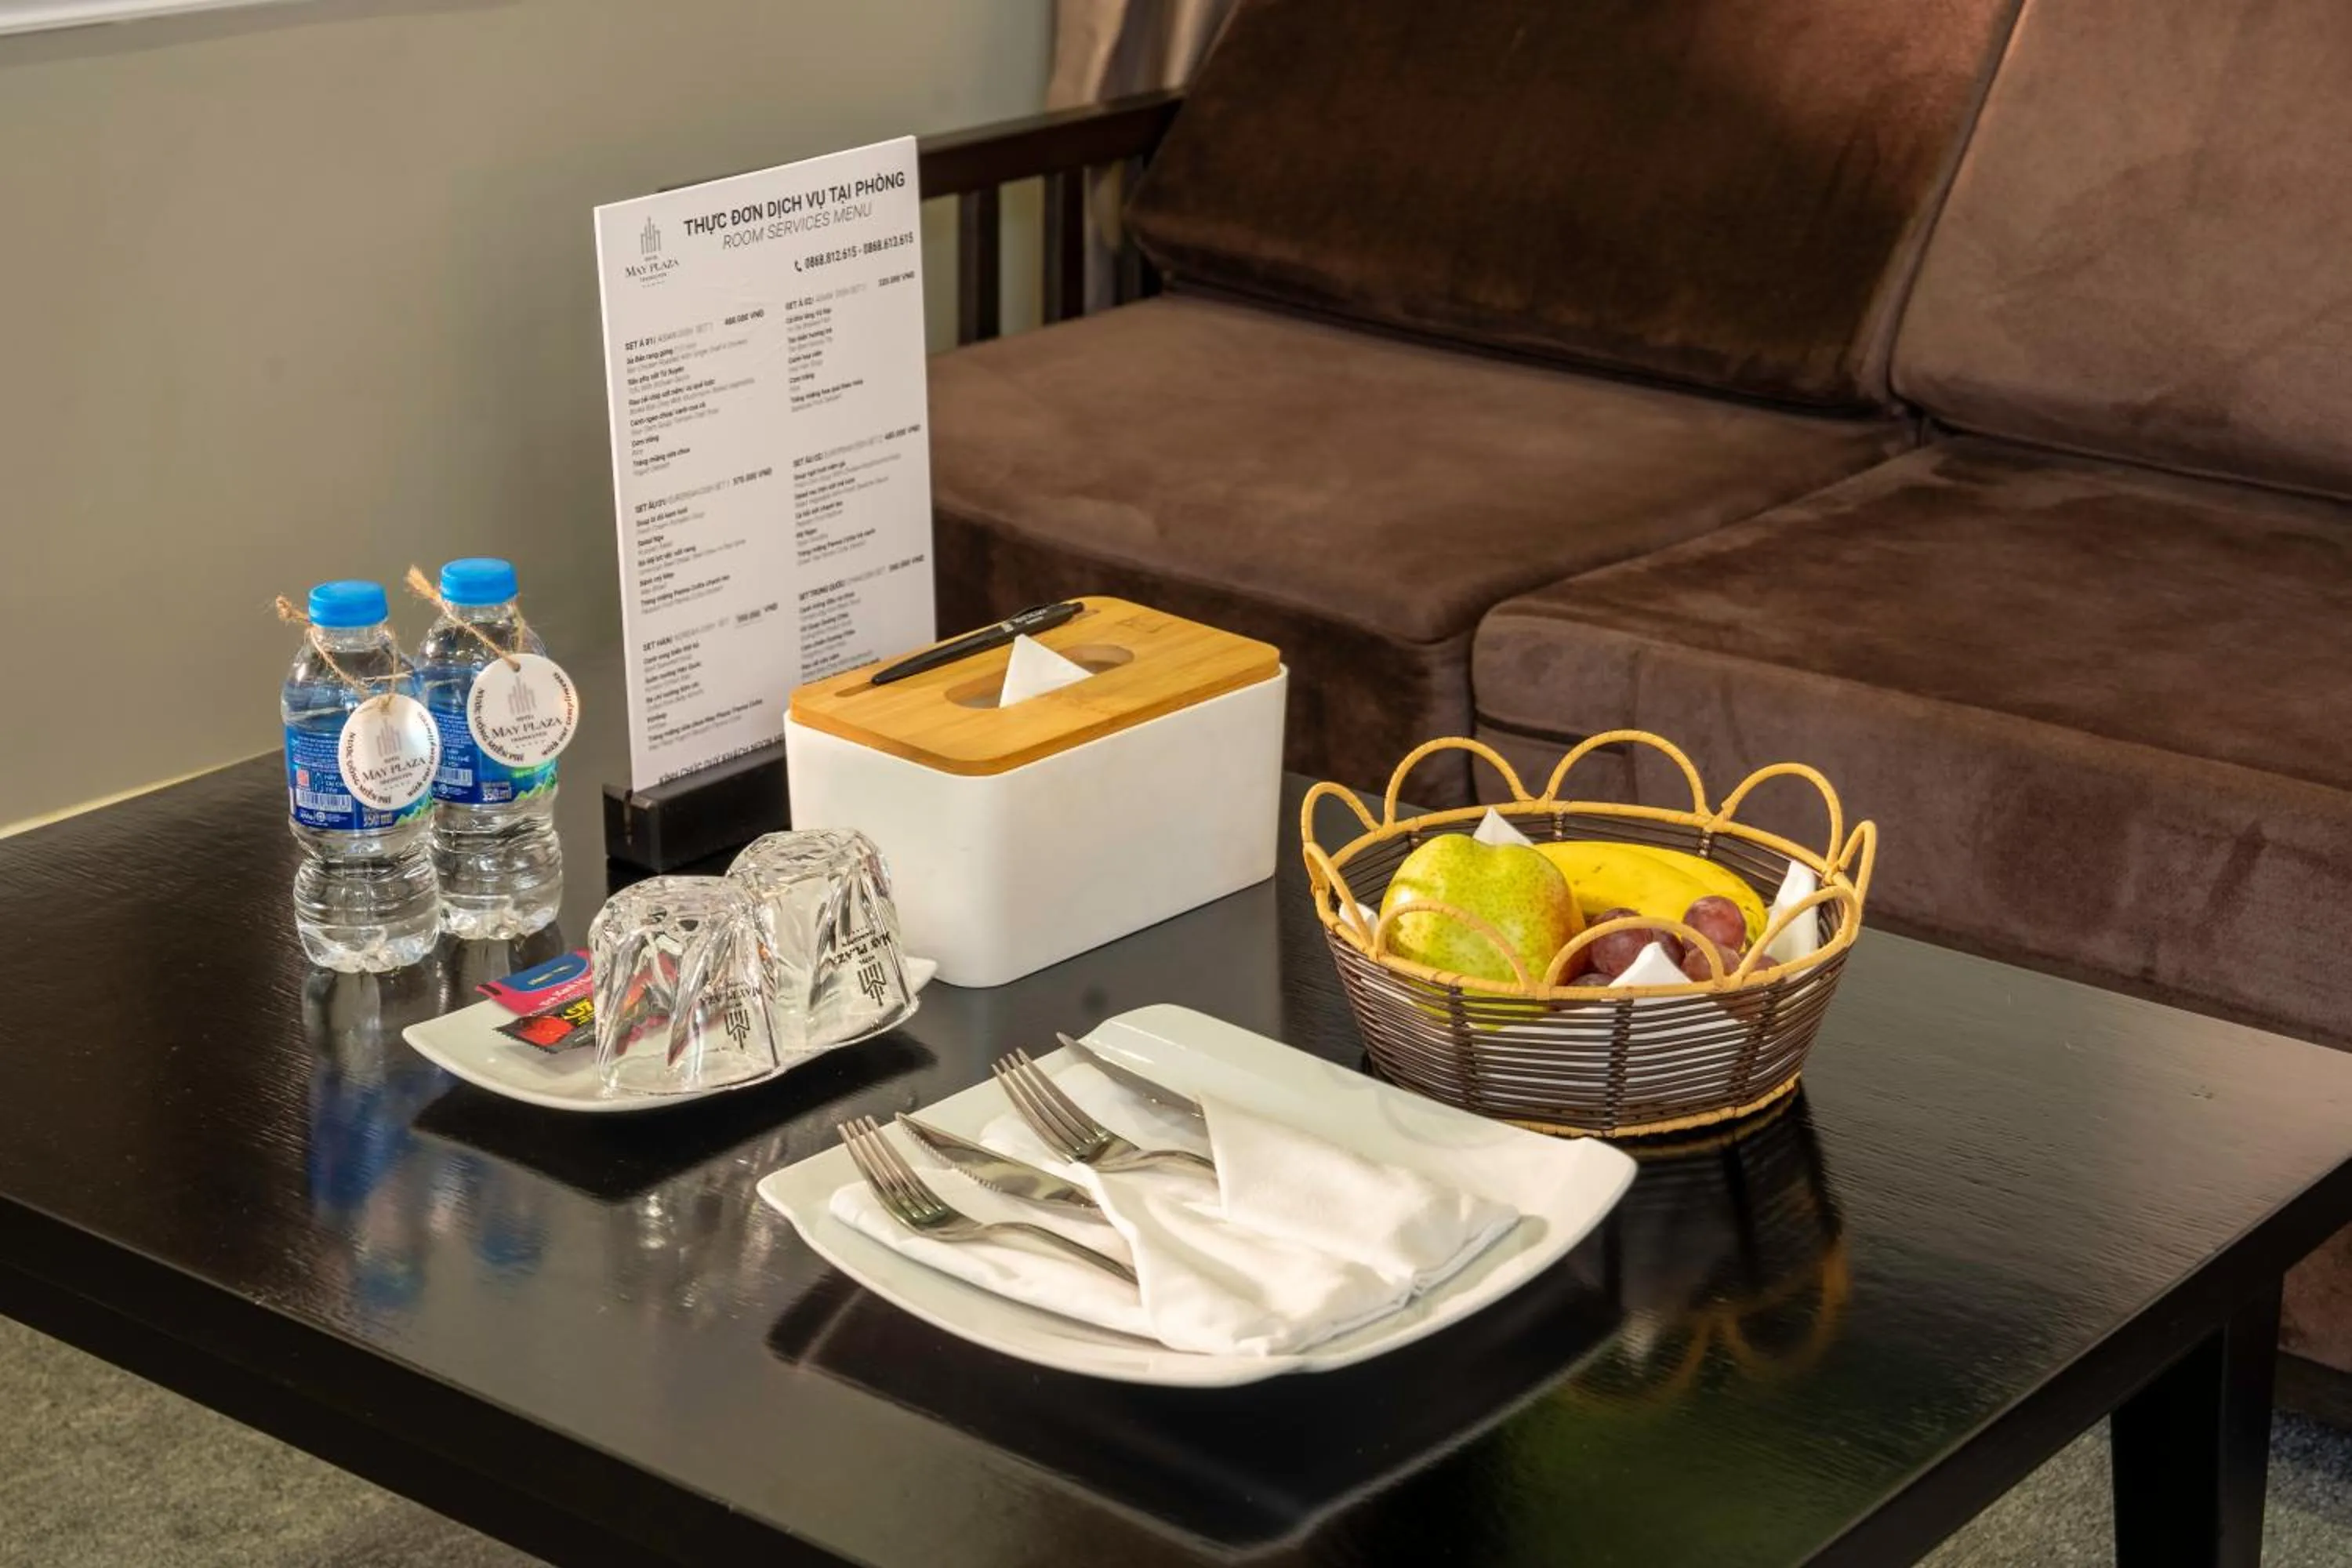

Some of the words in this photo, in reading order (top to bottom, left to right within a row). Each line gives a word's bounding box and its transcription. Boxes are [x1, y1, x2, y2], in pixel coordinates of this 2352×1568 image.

[684, 212, 728, 236] THỰC
[731, 204, 764, 226] ĐƠN
[768, 195, 802, 219] DỊCH
[805, 189, 826, 209] VỤ
[829, 183, 851, 202] TẠI
[855, 172, 906, 198] PHÒNG
[723, 229, 764, 249] ROOM
[768, 212, 830, 240] SERVICES
[833, 202, 873, 224] MENU
[626, 265, 646, 278] MAY
[649, 260, 679, 272] PLAZA
[625, 339, 637, 350] SET
[541, 740, 559, 756] with
[553, 672, 574, 725] compliments
[475, 716, 489, 741] UỐNG
[492, 726, 520, 738] MAY
[523, 717, 562, 732] PLAZA
[407, 781, 423, 797] with
[418, 711, 437, 765] compliments
[347, 760, 361, 786] UỐNG
[362, 767, 387, 781] MAY
[390, 757, 426, 774] PLAZA
